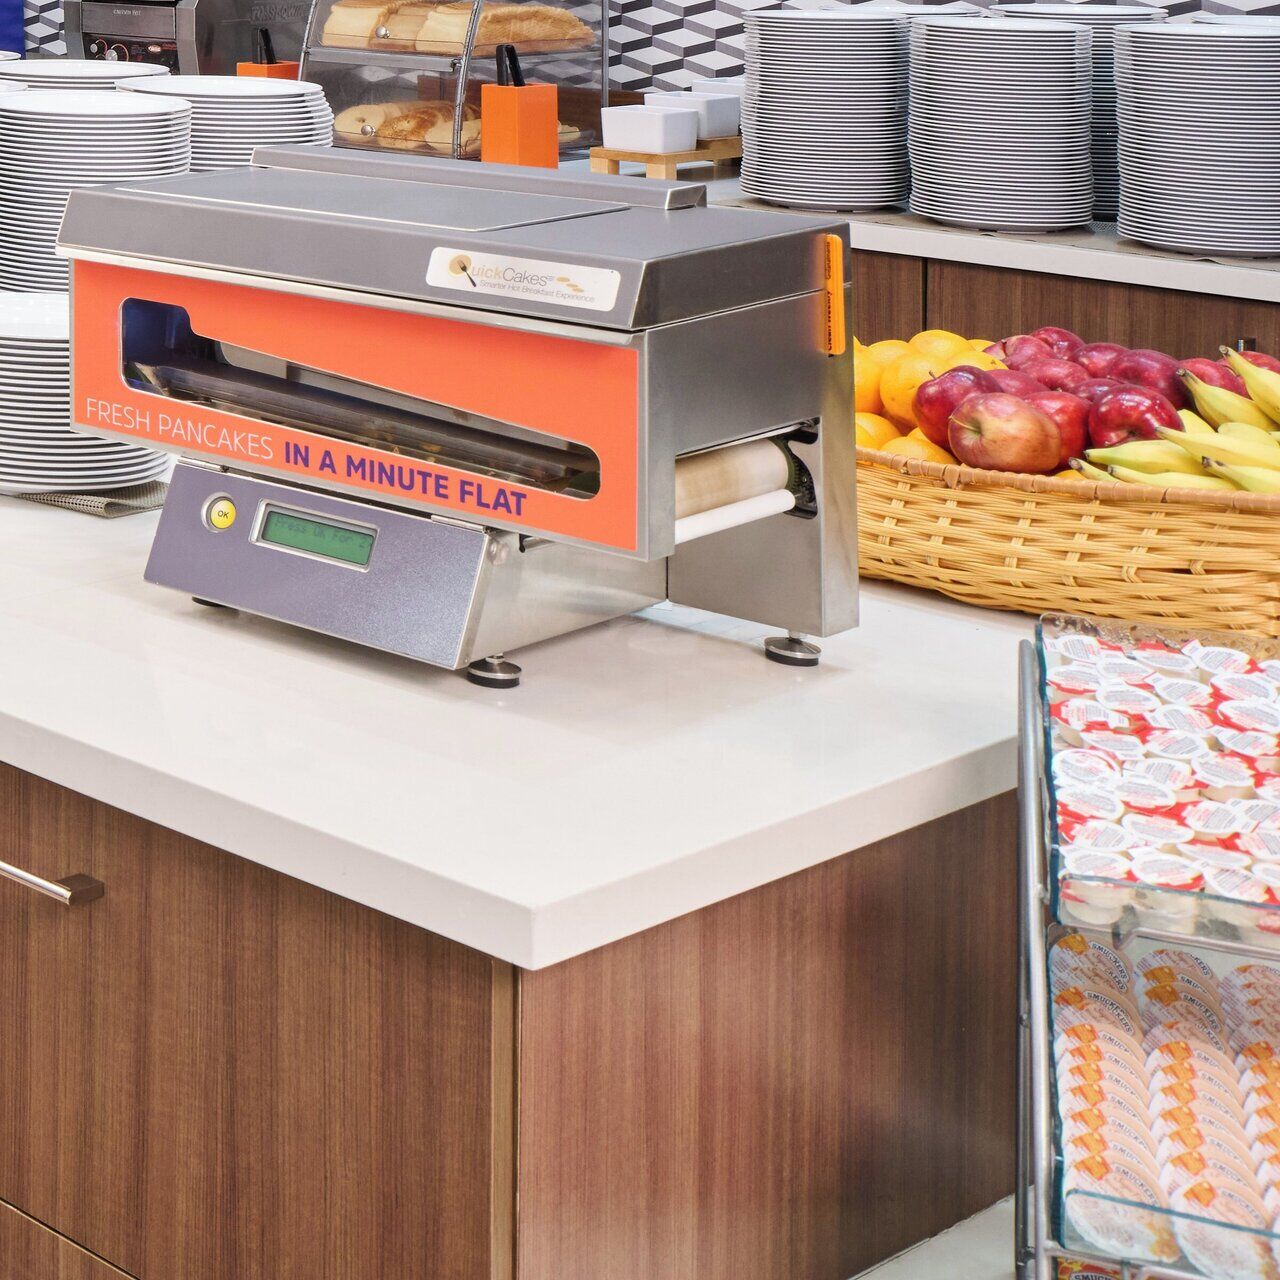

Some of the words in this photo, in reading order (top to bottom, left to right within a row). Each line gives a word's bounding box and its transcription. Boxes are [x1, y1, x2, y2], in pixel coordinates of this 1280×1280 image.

[86, 397, 150, 433] FRESH
[158, 413, 274, 460] PANCAKES
[284, 441, 310, 468] IN
[318, 450, 337, 474] A
[346, 454, 449, 500] MINUTE
[459, 479, 527, 516] FLAT
[217, 510, 229, 519] OK
